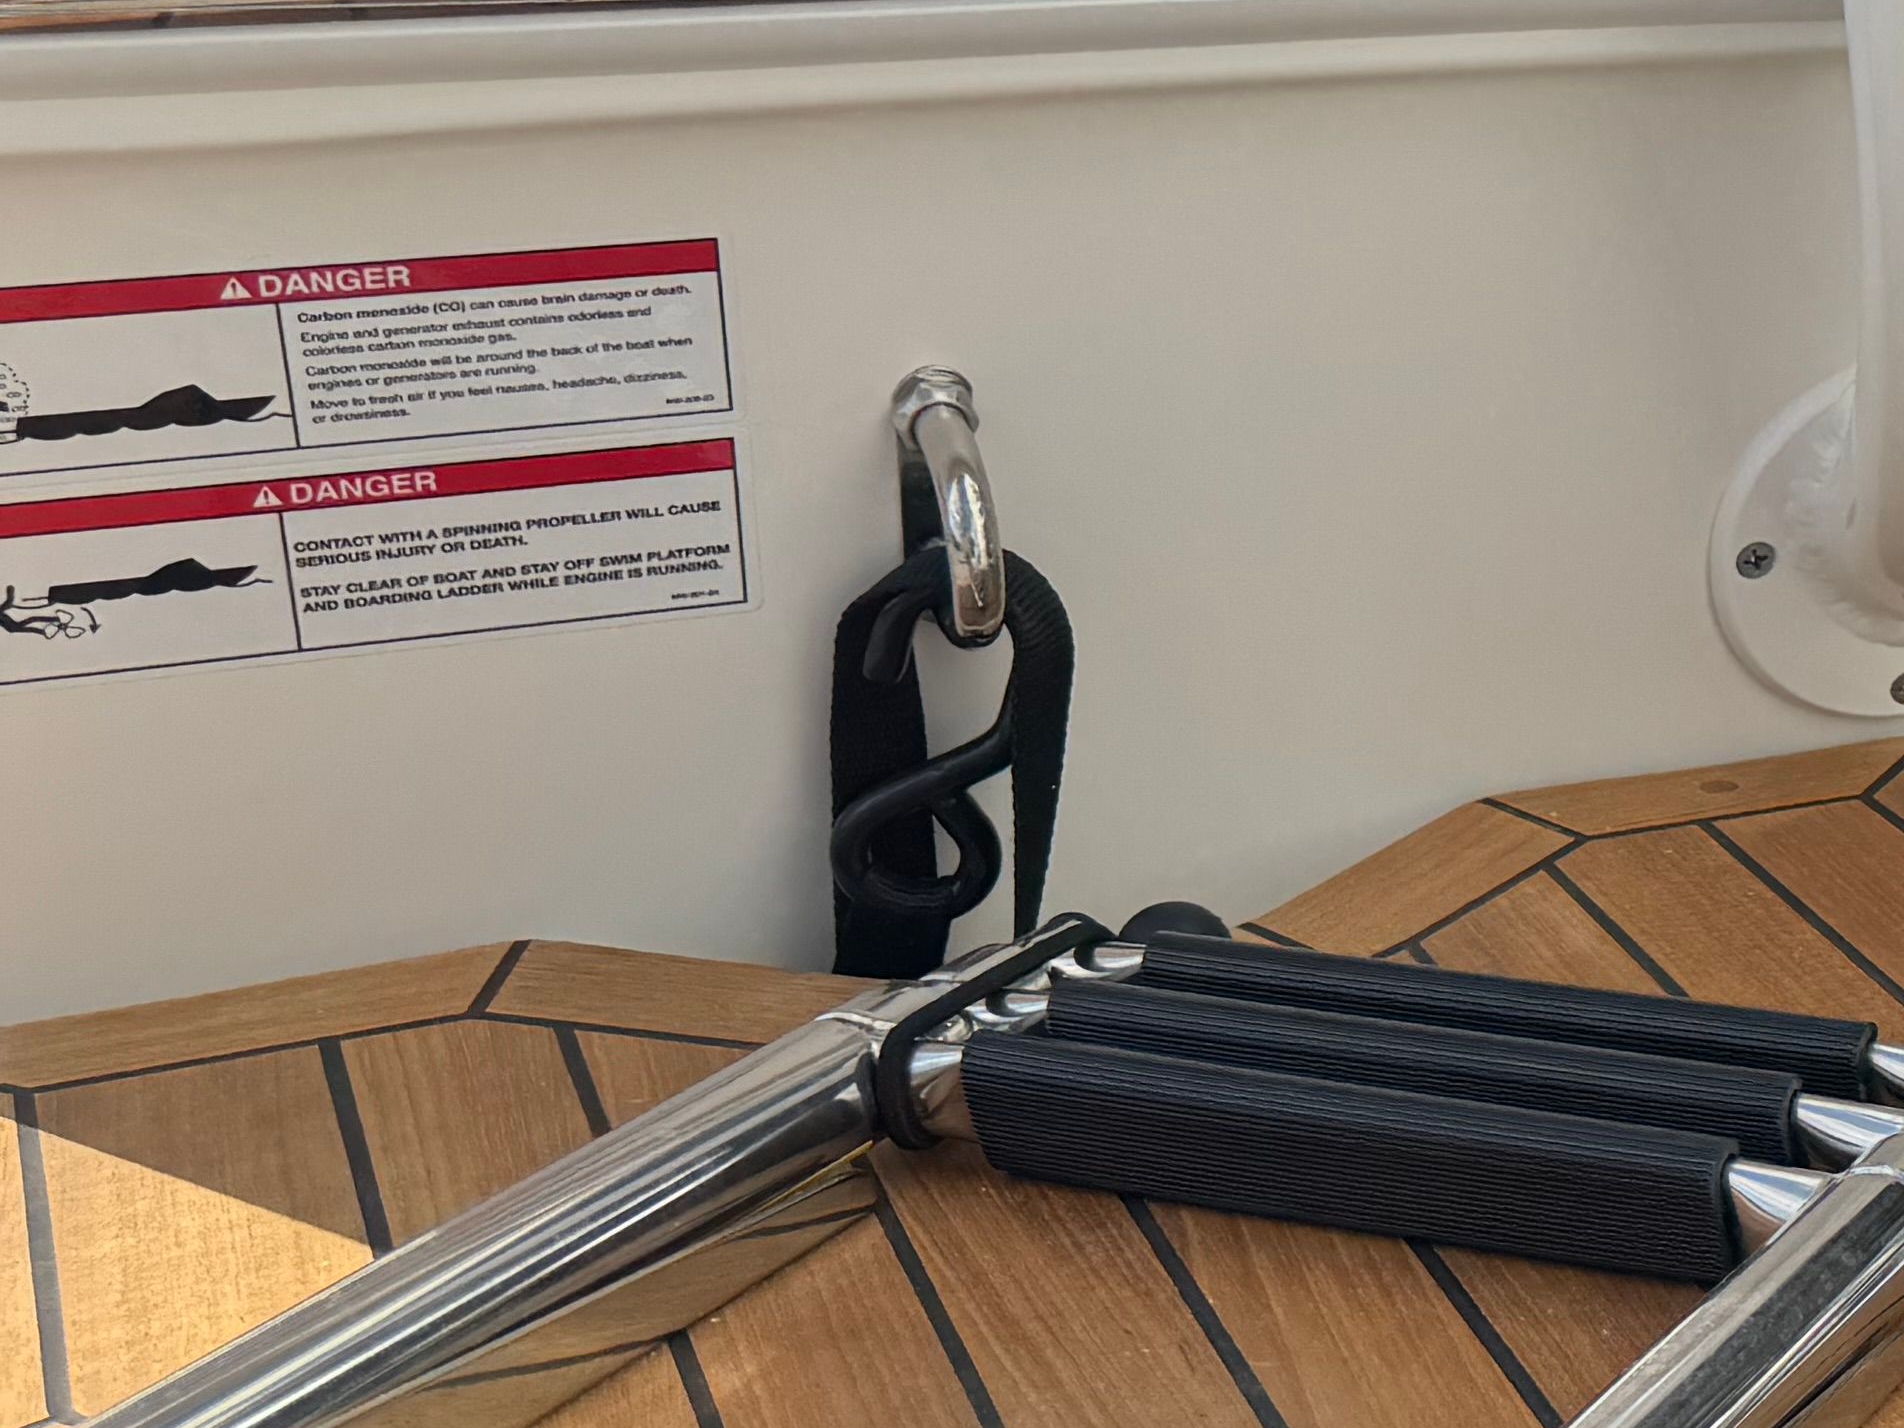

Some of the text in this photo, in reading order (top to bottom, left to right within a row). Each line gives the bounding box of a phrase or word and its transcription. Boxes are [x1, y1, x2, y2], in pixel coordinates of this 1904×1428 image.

[258, 265, 411, 298] DANGER
[297, 285, 691, 324] Carbon monoxide (CO) can cause brain damage or death.
[301, 306, 652, 343] Engine and generator exhaust contains odorless and
[302, 333, 517, 358] colorless carbon monoxide gas.
[305, 336, 693, 376] Carbon monoxide will be around the back of the boat when
[308, 378, 362, 392] engines
[366, 376, 380, 385] or
[383, 368, 456, 386] generators
[460, 366, 482, 377] are
[310, 399, 349, 409] Move
[352, 396, 366, 406] to
[369, 392, 404, 404] fresh
[408, 390, 424, 402] air
[428, 389, 437, 400] if
[439, 386, 465, 401] you
[468, 384, 492, 396] feel
[552, 376, 620, 389] headache,
[313, 413, 326, 424] or
[289, 471, 437, 505] DANGER
[293, 501, 721, 553] CONTACT WITH A SPINNING PROPELLER WILL CAUSE
[295, 535, 528, 568] SERIOUS INJURY OR DEATH.
[301, 544, 731, 599] STAY CLEAR OF BOAT AND STAY OFF SWIM PLATFORM
[303, 559, 723, 613] AND BOARDING LADDER WHILE ENGINE IS RUNNING.
